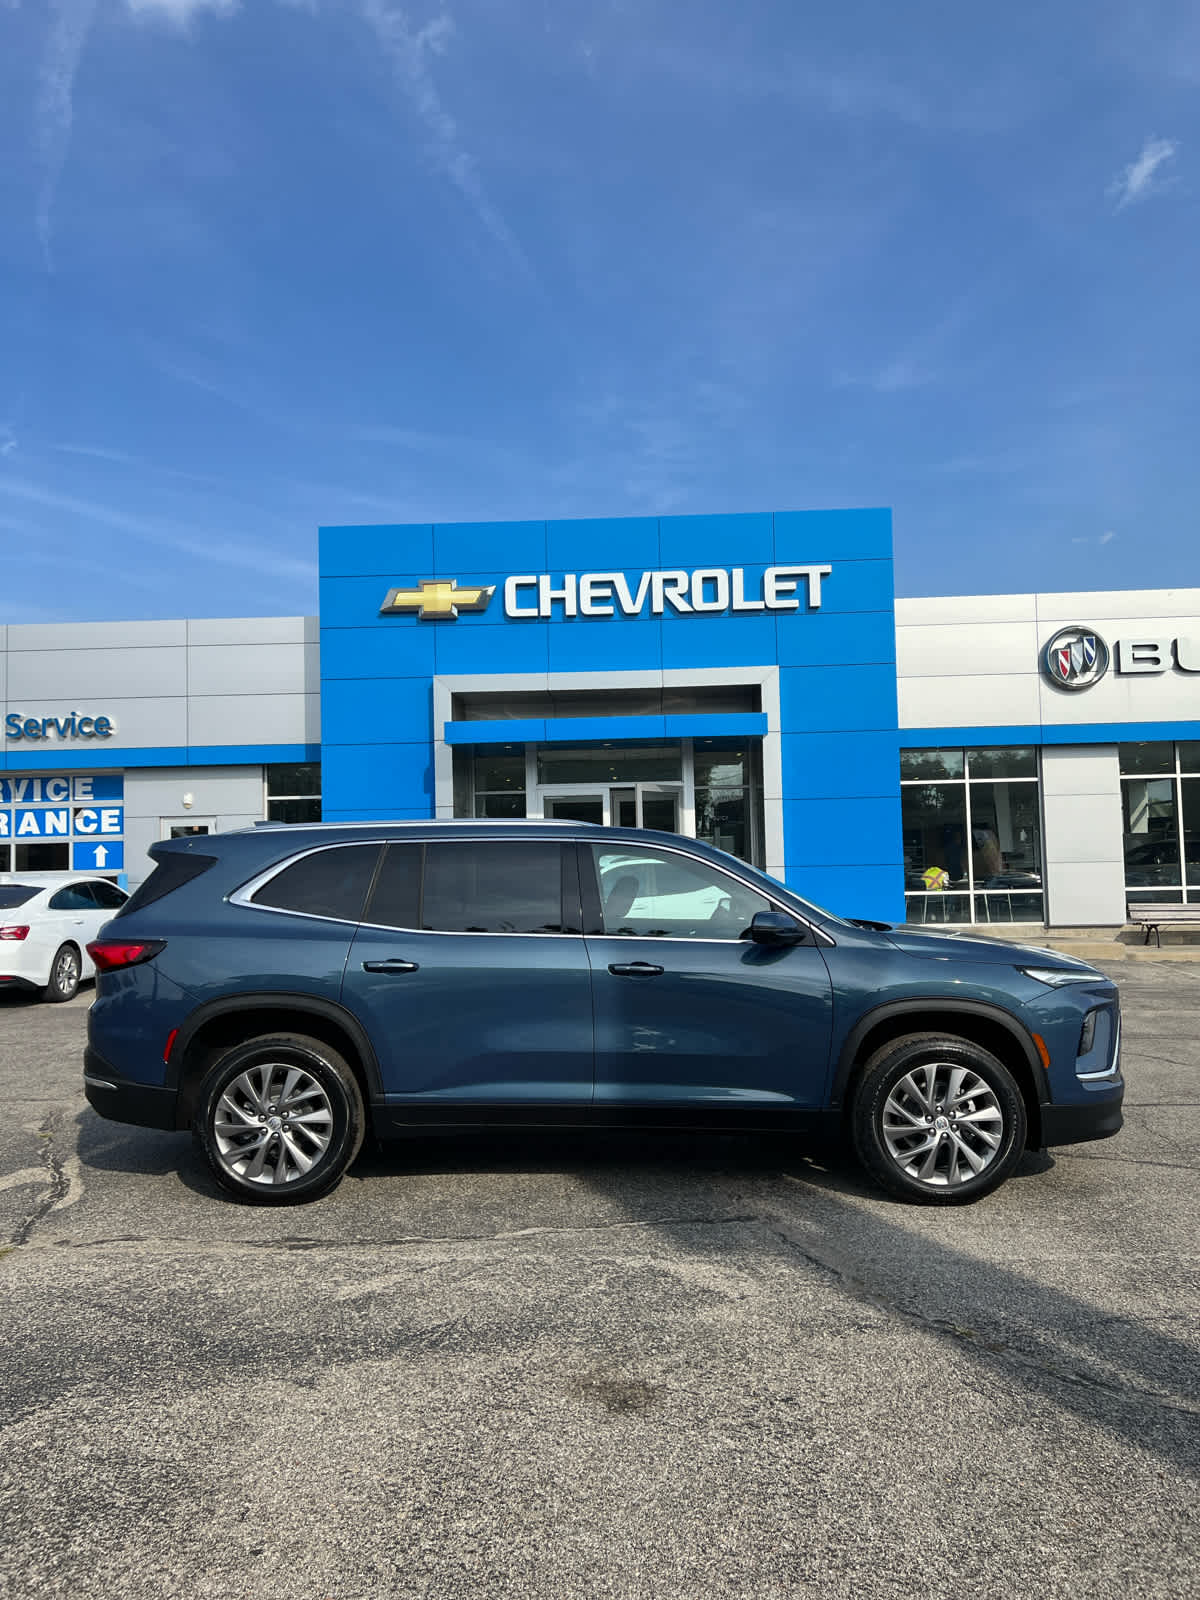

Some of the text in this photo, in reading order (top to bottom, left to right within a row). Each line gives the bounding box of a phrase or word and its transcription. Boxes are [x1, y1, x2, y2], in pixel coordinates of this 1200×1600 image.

[505, 565, 832, 617] CHEVROLET
[5, 711, 110, 737] Service
[0, 777, 94, 803] VICE
